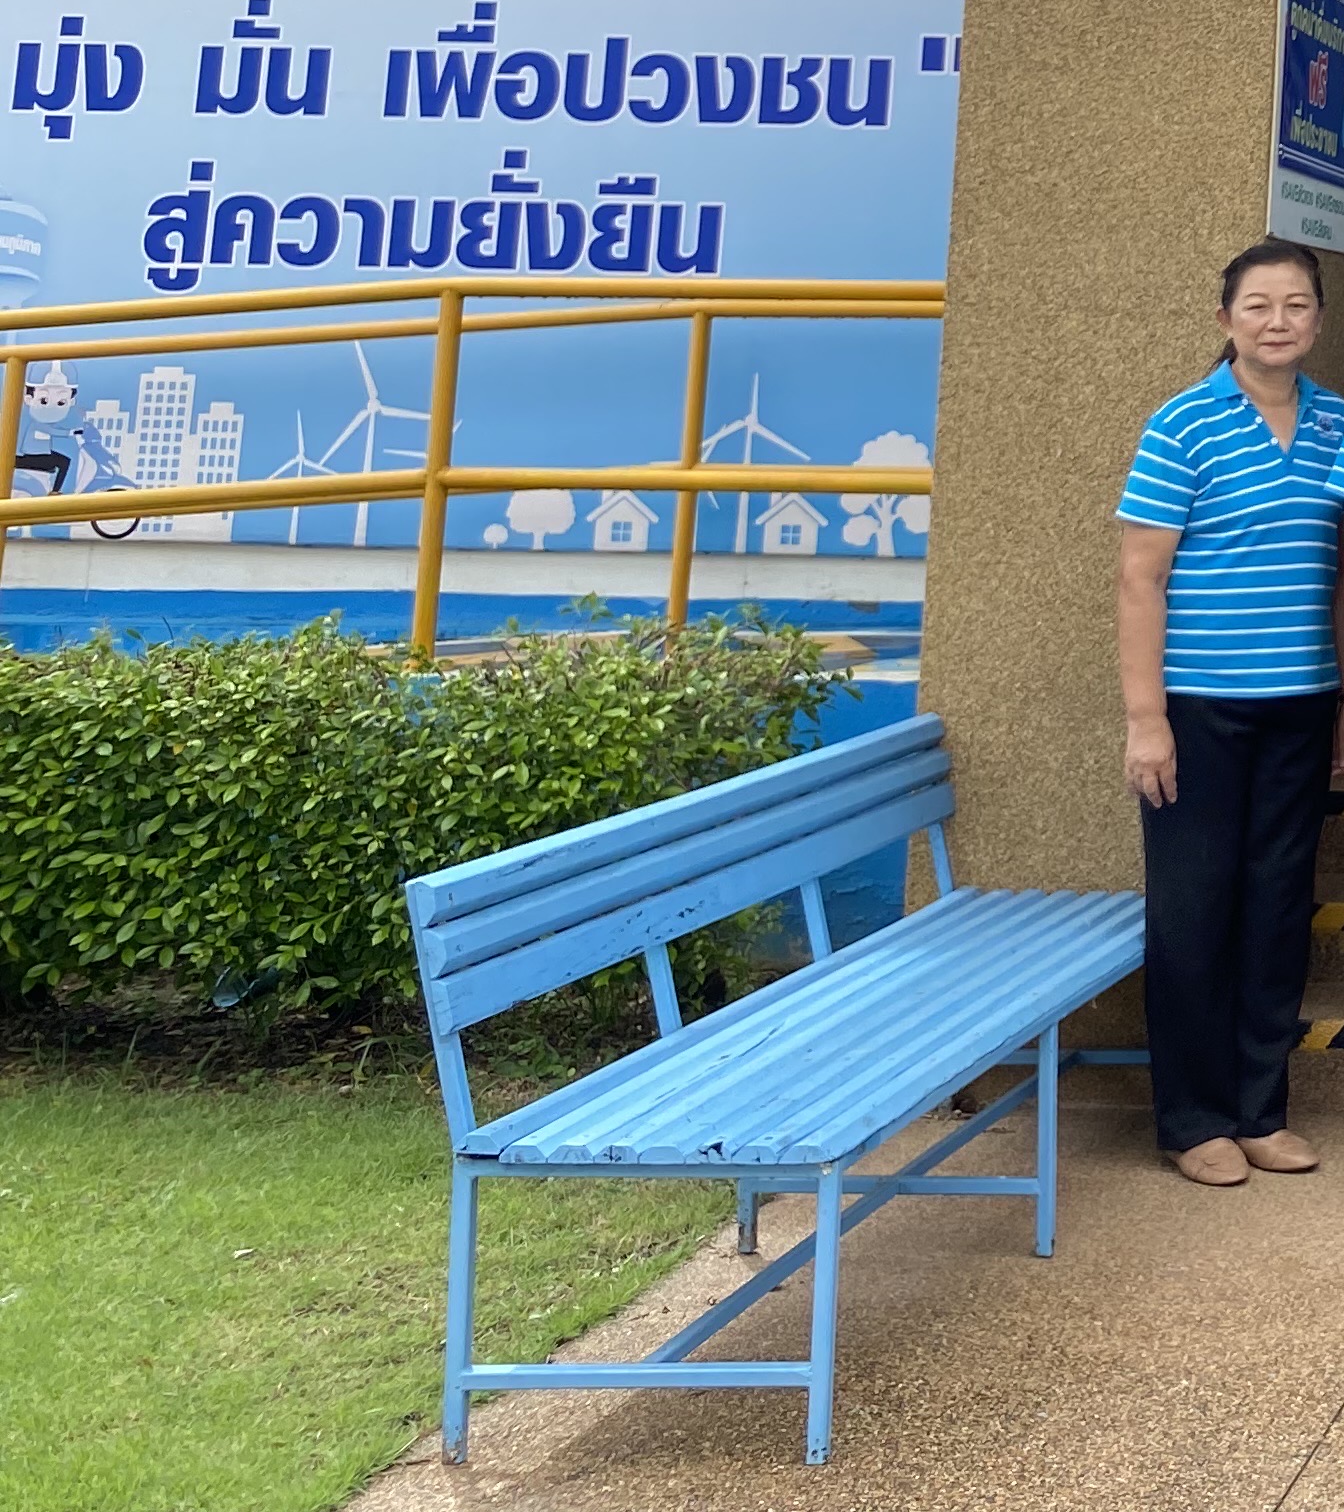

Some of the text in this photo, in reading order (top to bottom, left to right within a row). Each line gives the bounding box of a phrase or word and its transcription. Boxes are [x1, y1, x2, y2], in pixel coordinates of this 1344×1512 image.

[9, 15, 146, 141] มุ่ง
[382, 0, 896, 130] เพื่อปวงชน
[142, 149, 727, 294] สู่ความยั่งยืน
